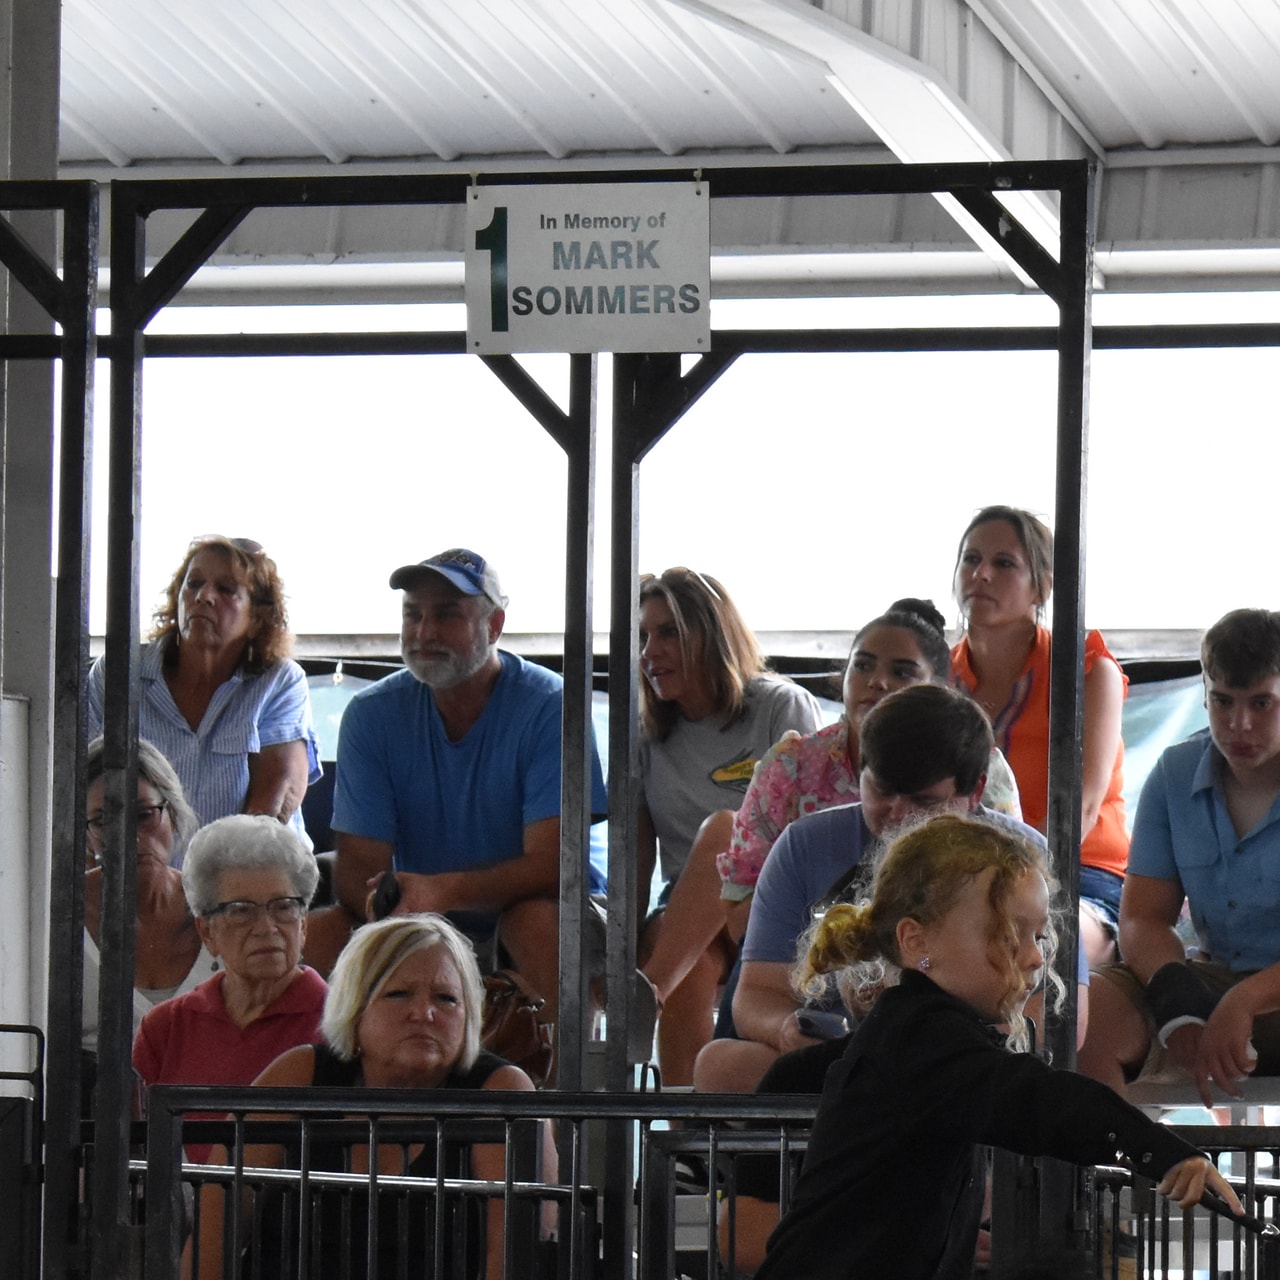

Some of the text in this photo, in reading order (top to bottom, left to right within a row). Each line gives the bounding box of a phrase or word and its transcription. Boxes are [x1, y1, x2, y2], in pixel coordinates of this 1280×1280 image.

[540, 212, 666, 232] In Memory of
[474, 206, 509, 332] 1
[552, 239, 660, 271] MARK
[511, 283, 701, 316] SOMMERS
